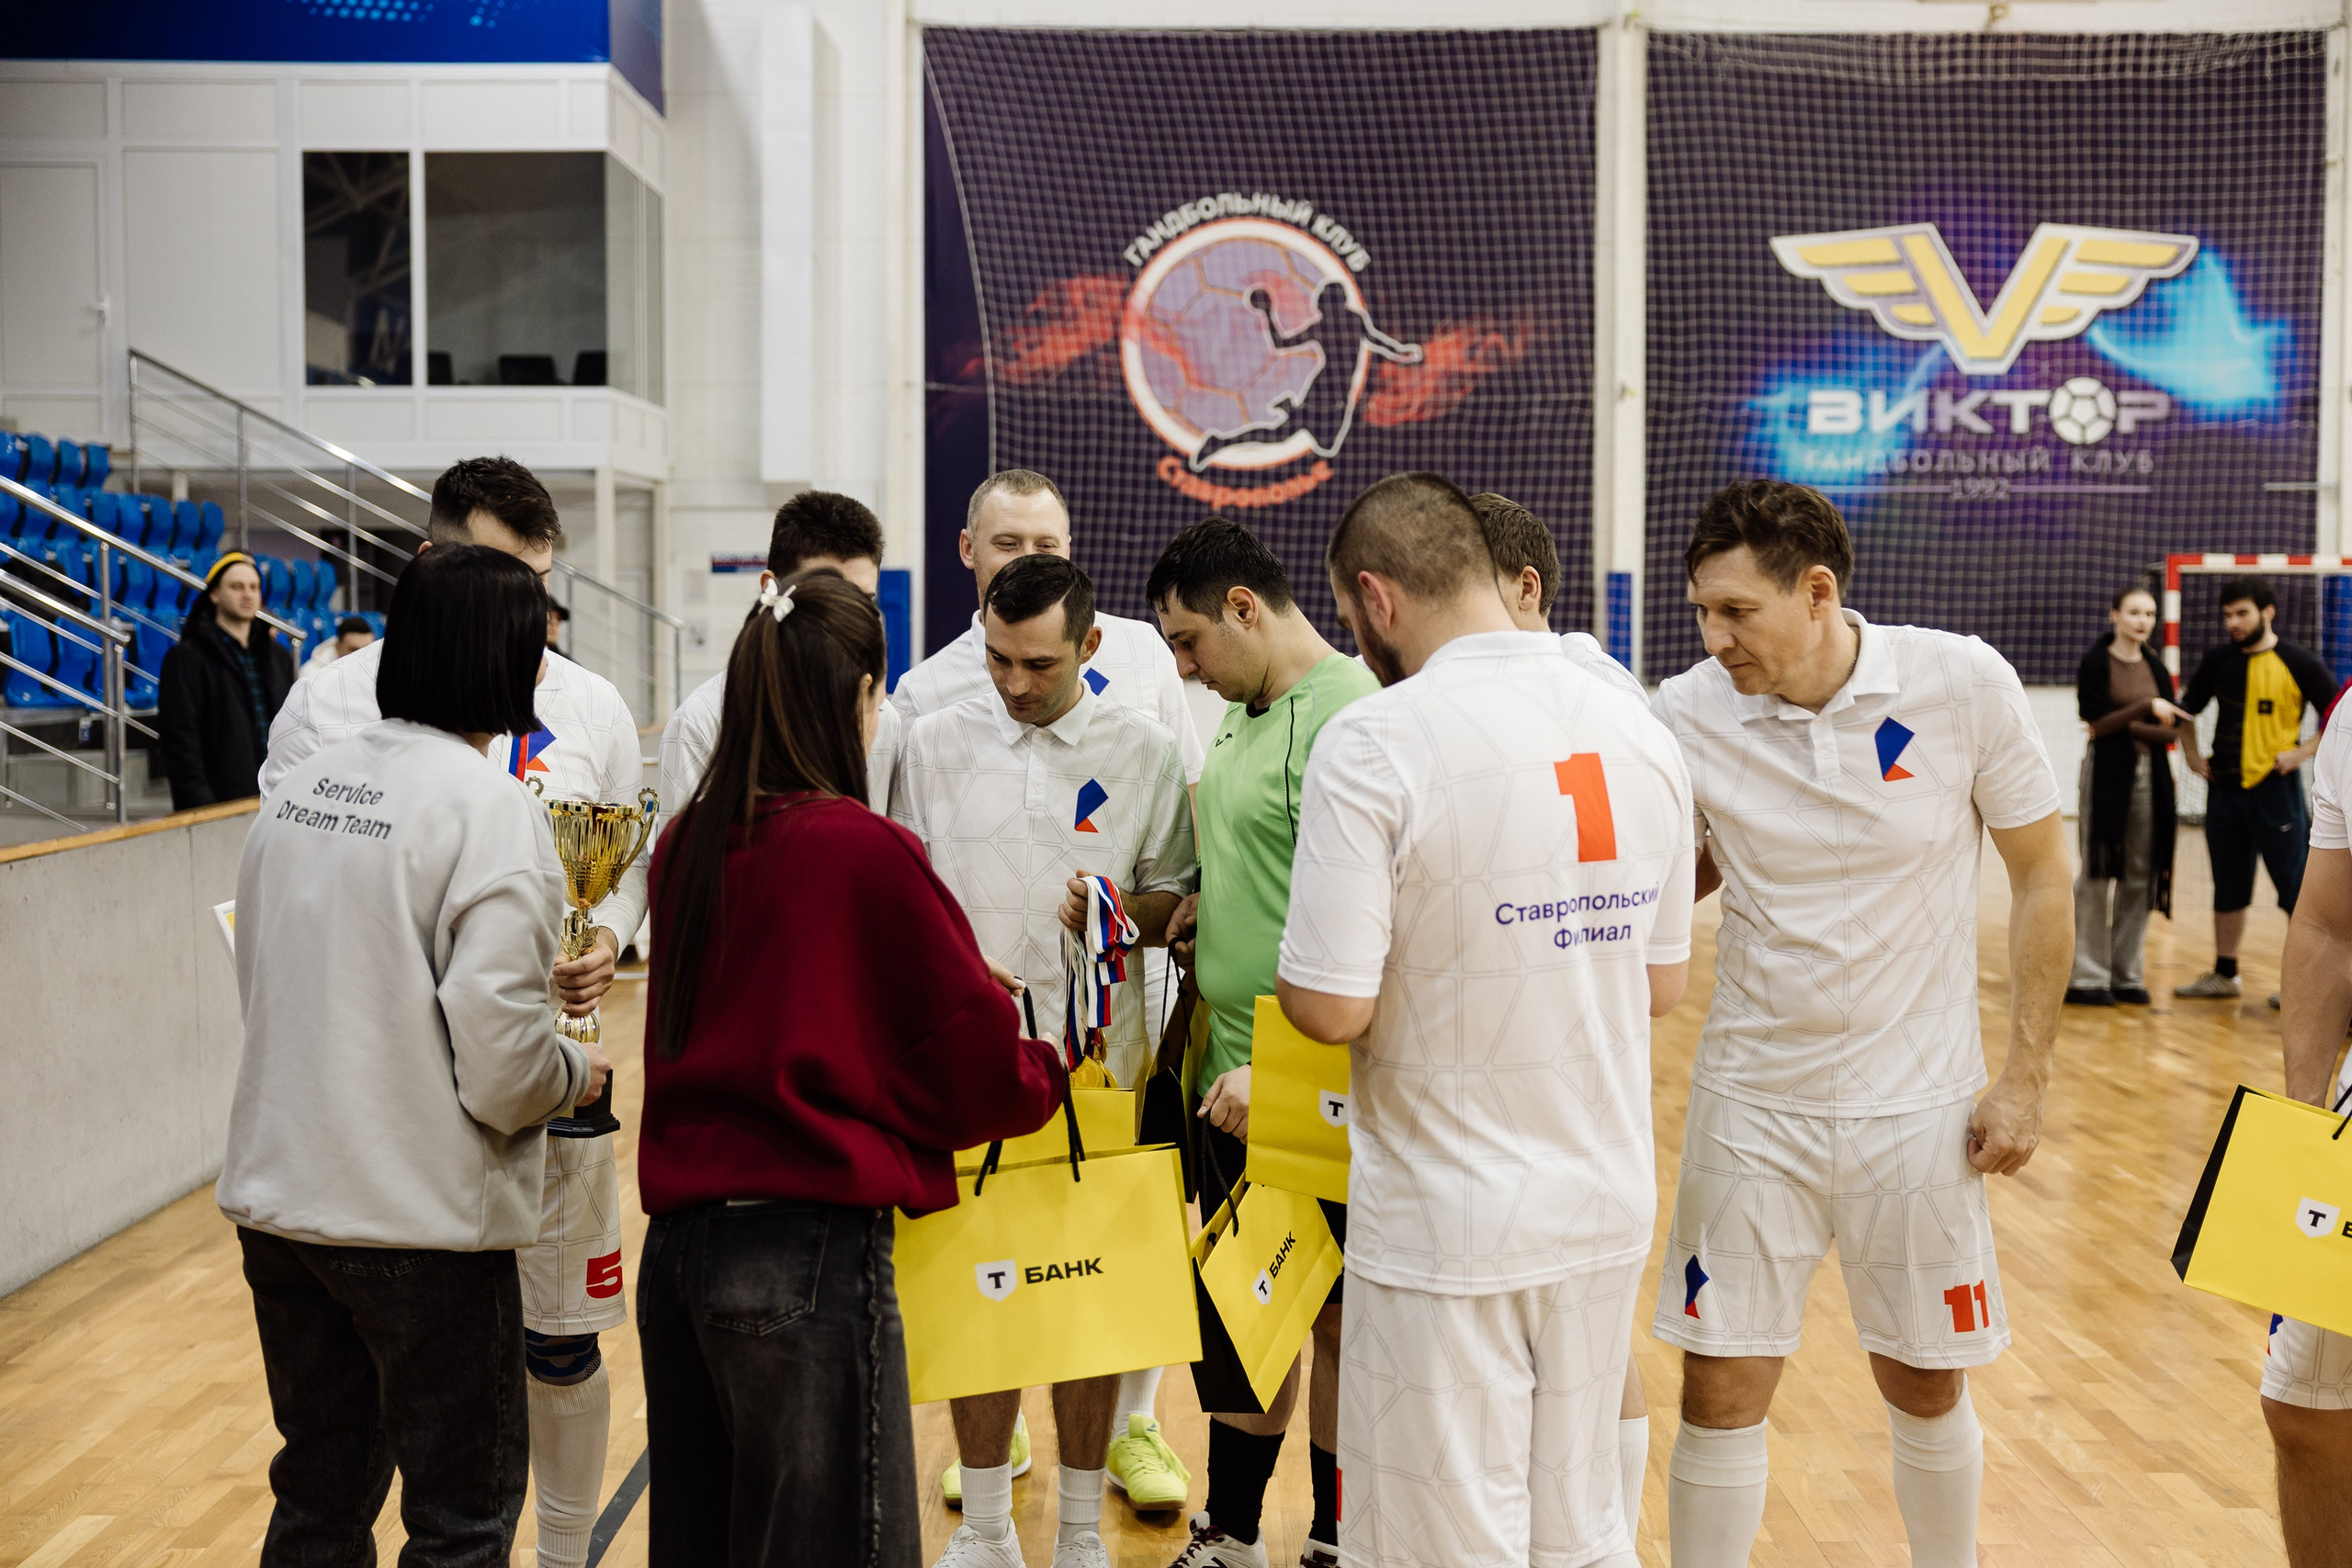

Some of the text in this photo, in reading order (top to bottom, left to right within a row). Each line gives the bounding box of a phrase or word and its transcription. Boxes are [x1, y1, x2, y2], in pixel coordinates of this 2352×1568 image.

[1123, 191, 1372, 273] ГАНДБОЛЬНЫЙ КЛУБ
[1808, 377, 2171, 446] ВИКТОР
[1805, 445, 2155, 475] ГАНДБОЛЬНЫЙ КЛУБ
[1950, 476, 2011, 502] 1992
[312, 776, 384, 806] Service
[1554, 751, 1618, 863] 1
[276, 799, 392, 840] Dream Team
[1496, 882, 1660, 925] Ставропольский
[1553, 924, 1632, 950] Филиал
[586, 1247, 623, 1299] 5
[1024, 1257, 1104, 1284] БАНК
[1268, 1230, 1296, 1280] БАНК
[1943, 1279, 1990, 1333] 11
